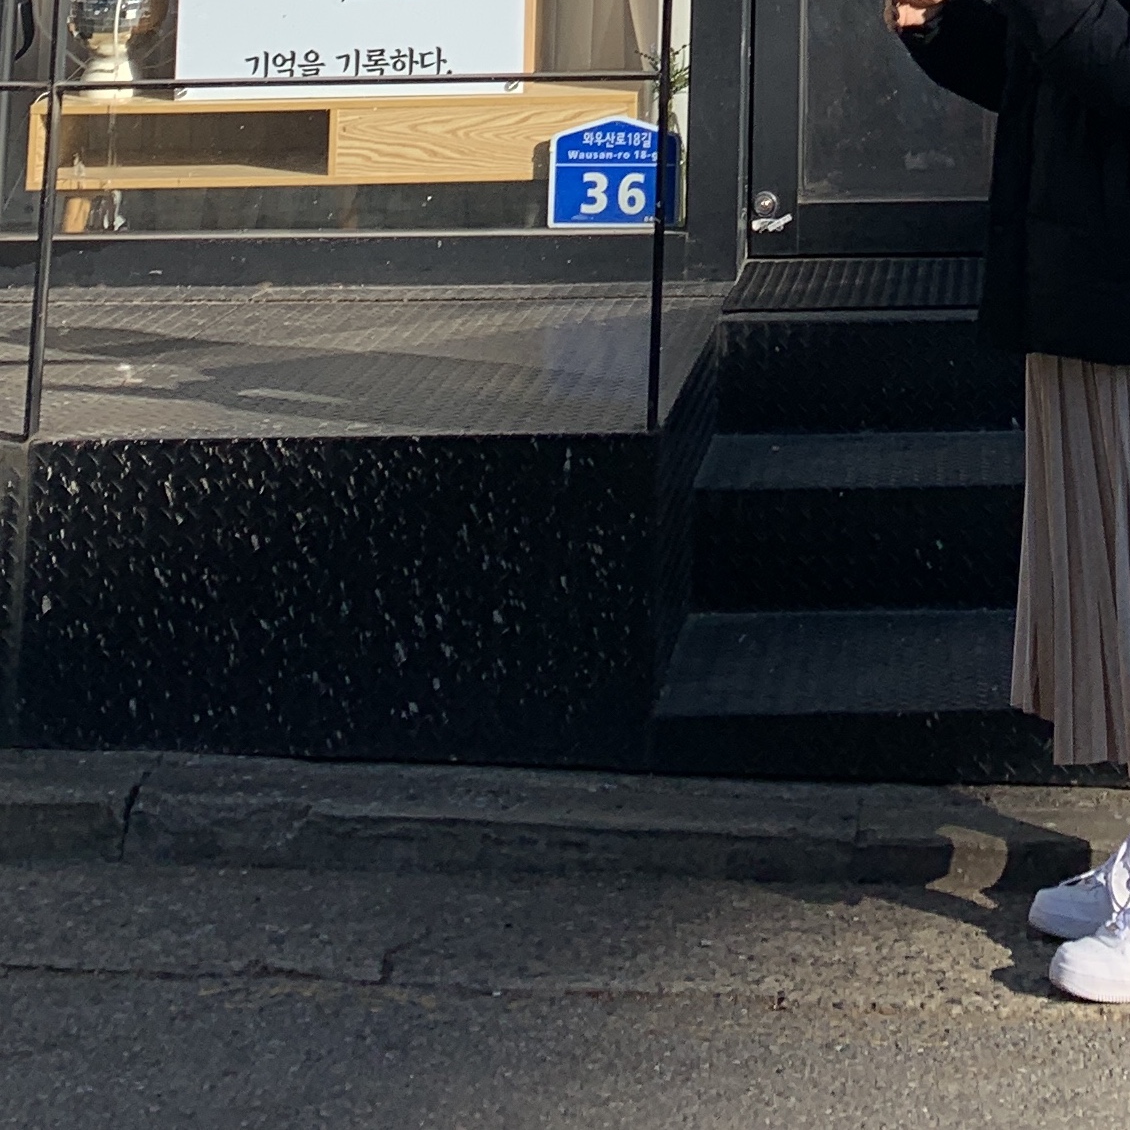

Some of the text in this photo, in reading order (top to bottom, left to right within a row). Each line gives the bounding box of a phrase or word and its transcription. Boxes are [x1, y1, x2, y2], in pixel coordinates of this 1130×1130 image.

[245, 45, 454, 78] 기억을 기록하다.
[582, 131, 652, 148] 와우산로18길
[567, 150, 630, 160] Wausan-ro
[580, 172, 646, 215] 36
